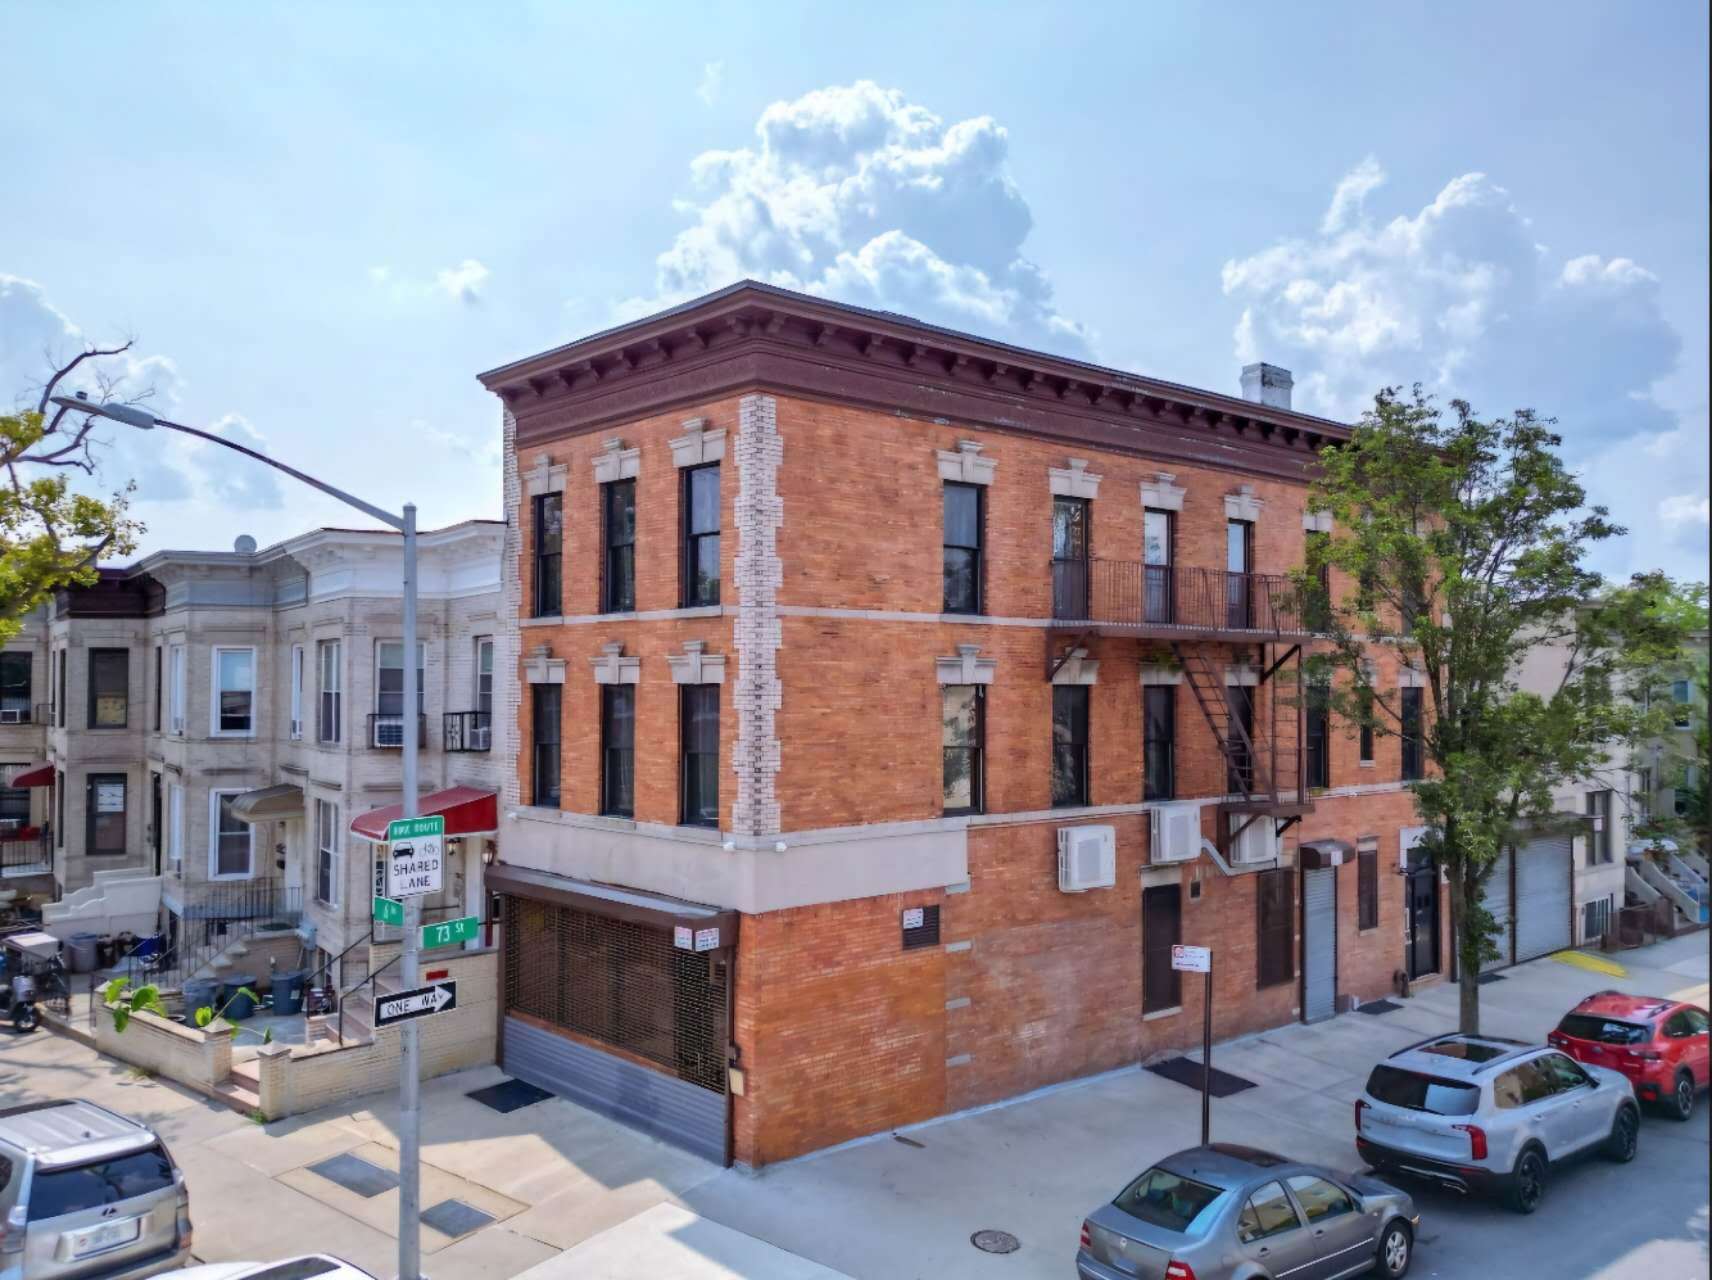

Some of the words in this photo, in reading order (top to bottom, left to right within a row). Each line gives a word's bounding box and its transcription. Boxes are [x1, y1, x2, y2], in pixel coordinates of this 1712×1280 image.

[393, 859, 439, 877] SHARED
[400, 875, 431, 889] LANE
[436, 925, 450, 943] 73
[386, 999, 410, 1015] ONE
[421, 993, 444, 1007] WAY
